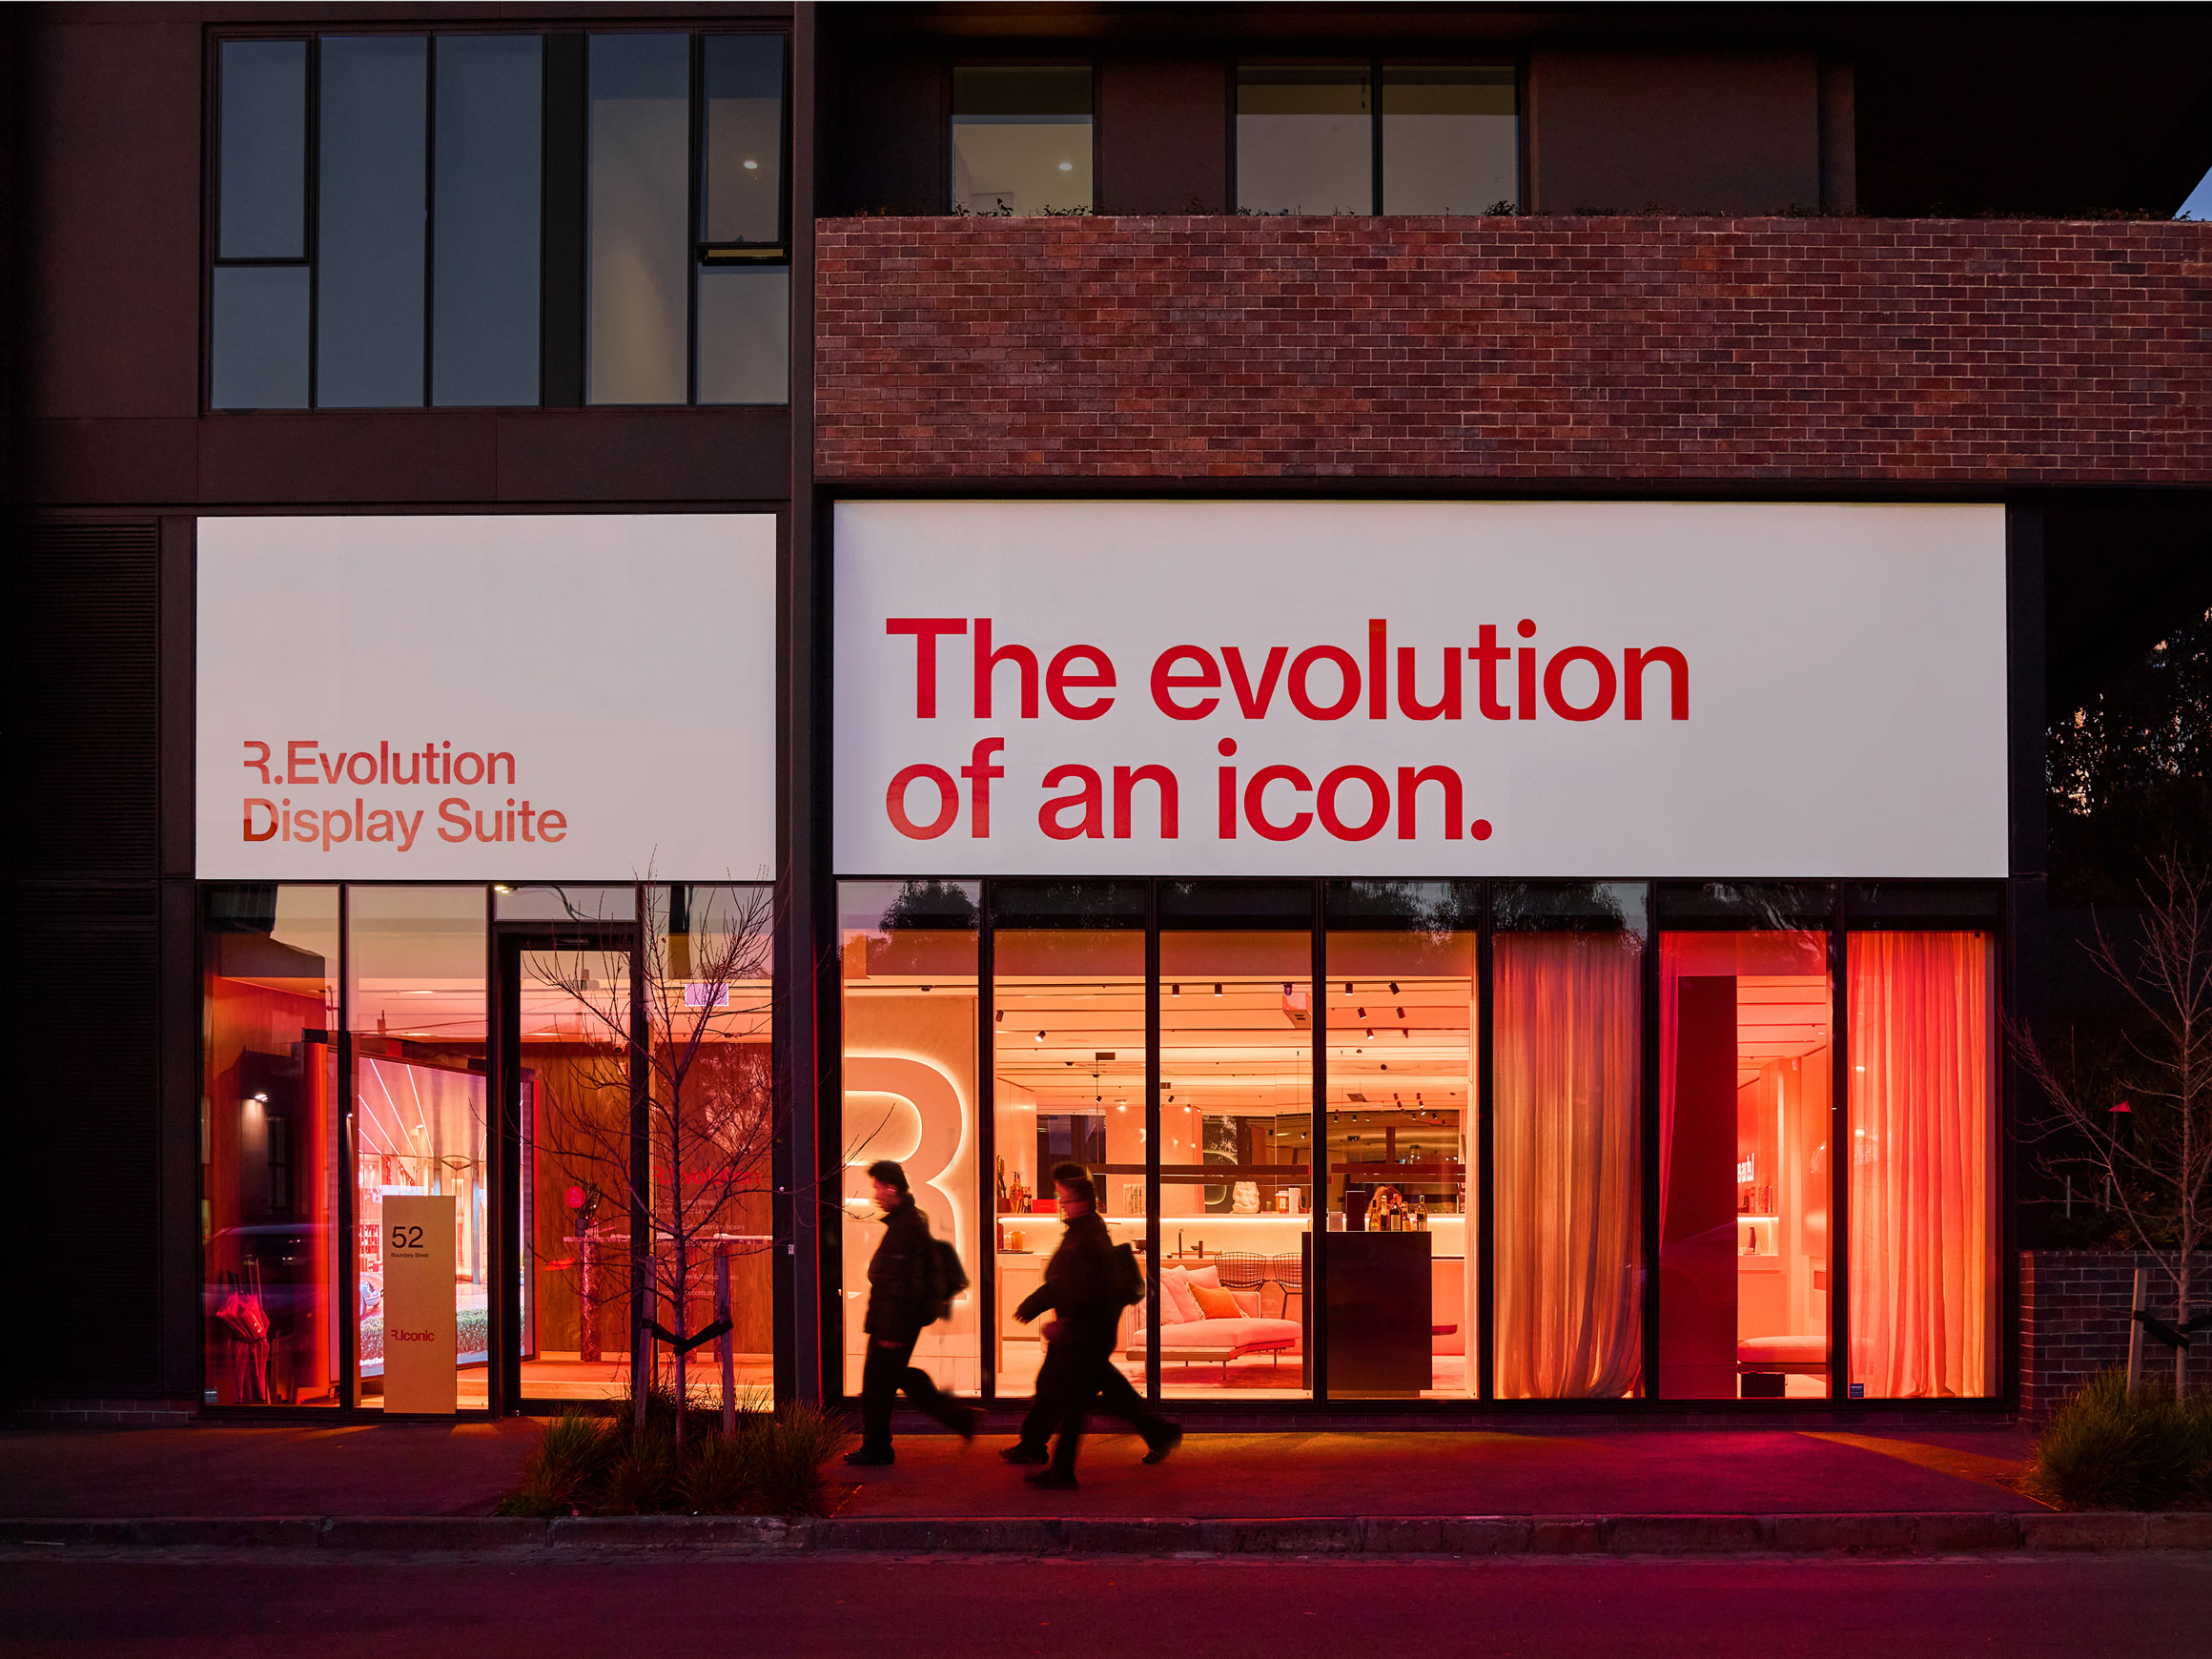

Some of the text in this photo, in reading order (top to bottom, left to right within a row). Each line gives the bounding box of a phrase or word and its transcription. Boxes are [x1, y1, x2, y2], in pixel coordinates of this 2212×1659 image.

[886, 618, 1690, 722] The evolution
[243, 740, 516, 786] R.Evolution
[886, 737, 1493, 842] of an icon.
[243, 797, 567, 852] Display Suite
[391, 1226, 423, 1248] 52
[391, 1329, 436, 1342] R.Iconic
